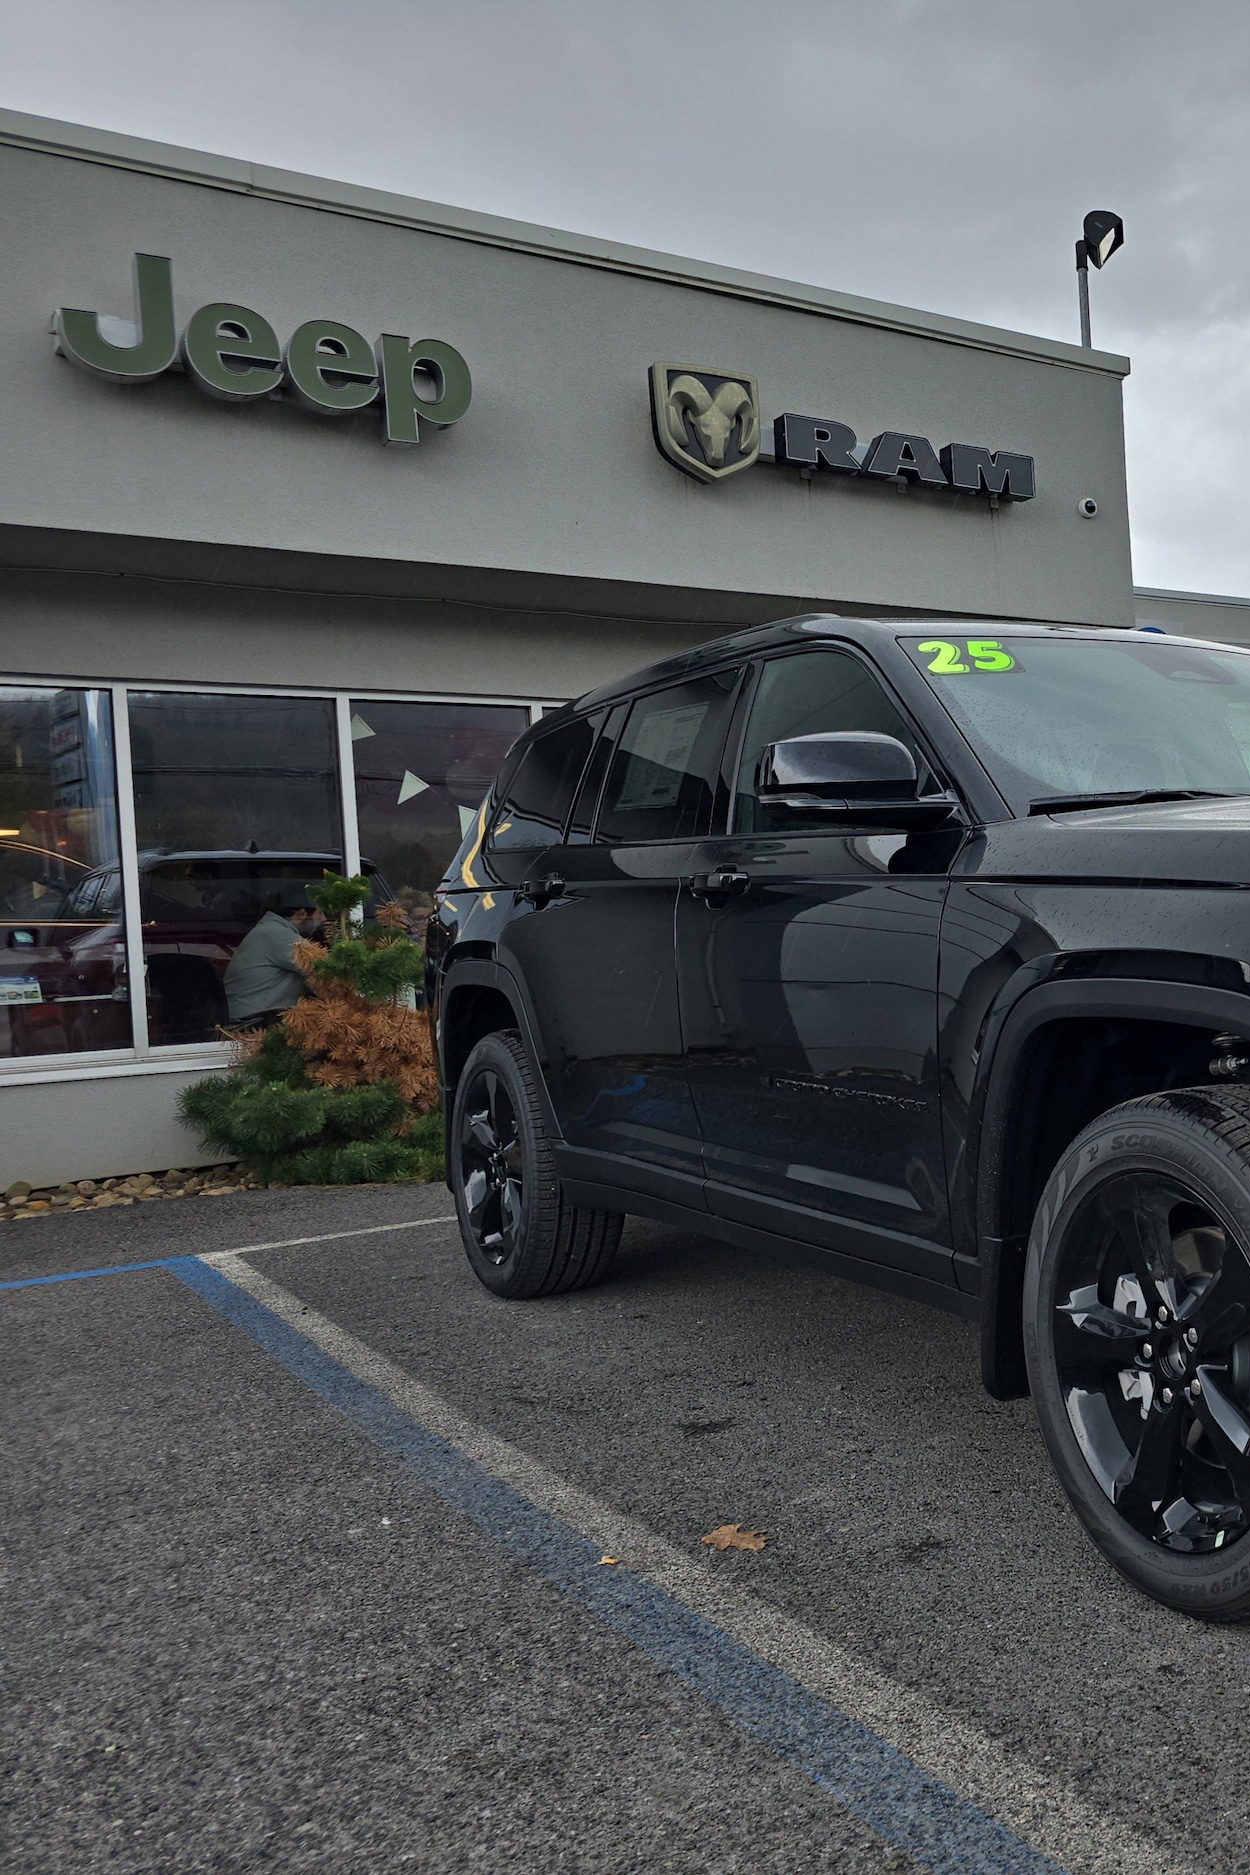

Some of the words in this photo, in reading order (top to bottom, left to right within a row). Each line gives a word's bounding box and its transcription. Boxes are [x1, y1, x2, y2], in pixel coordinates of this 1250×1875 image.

[56, 253, 472, 445] Jeep
[774, 412, 1036, 503] RAM
[918, 640, 1015, 674] 25
